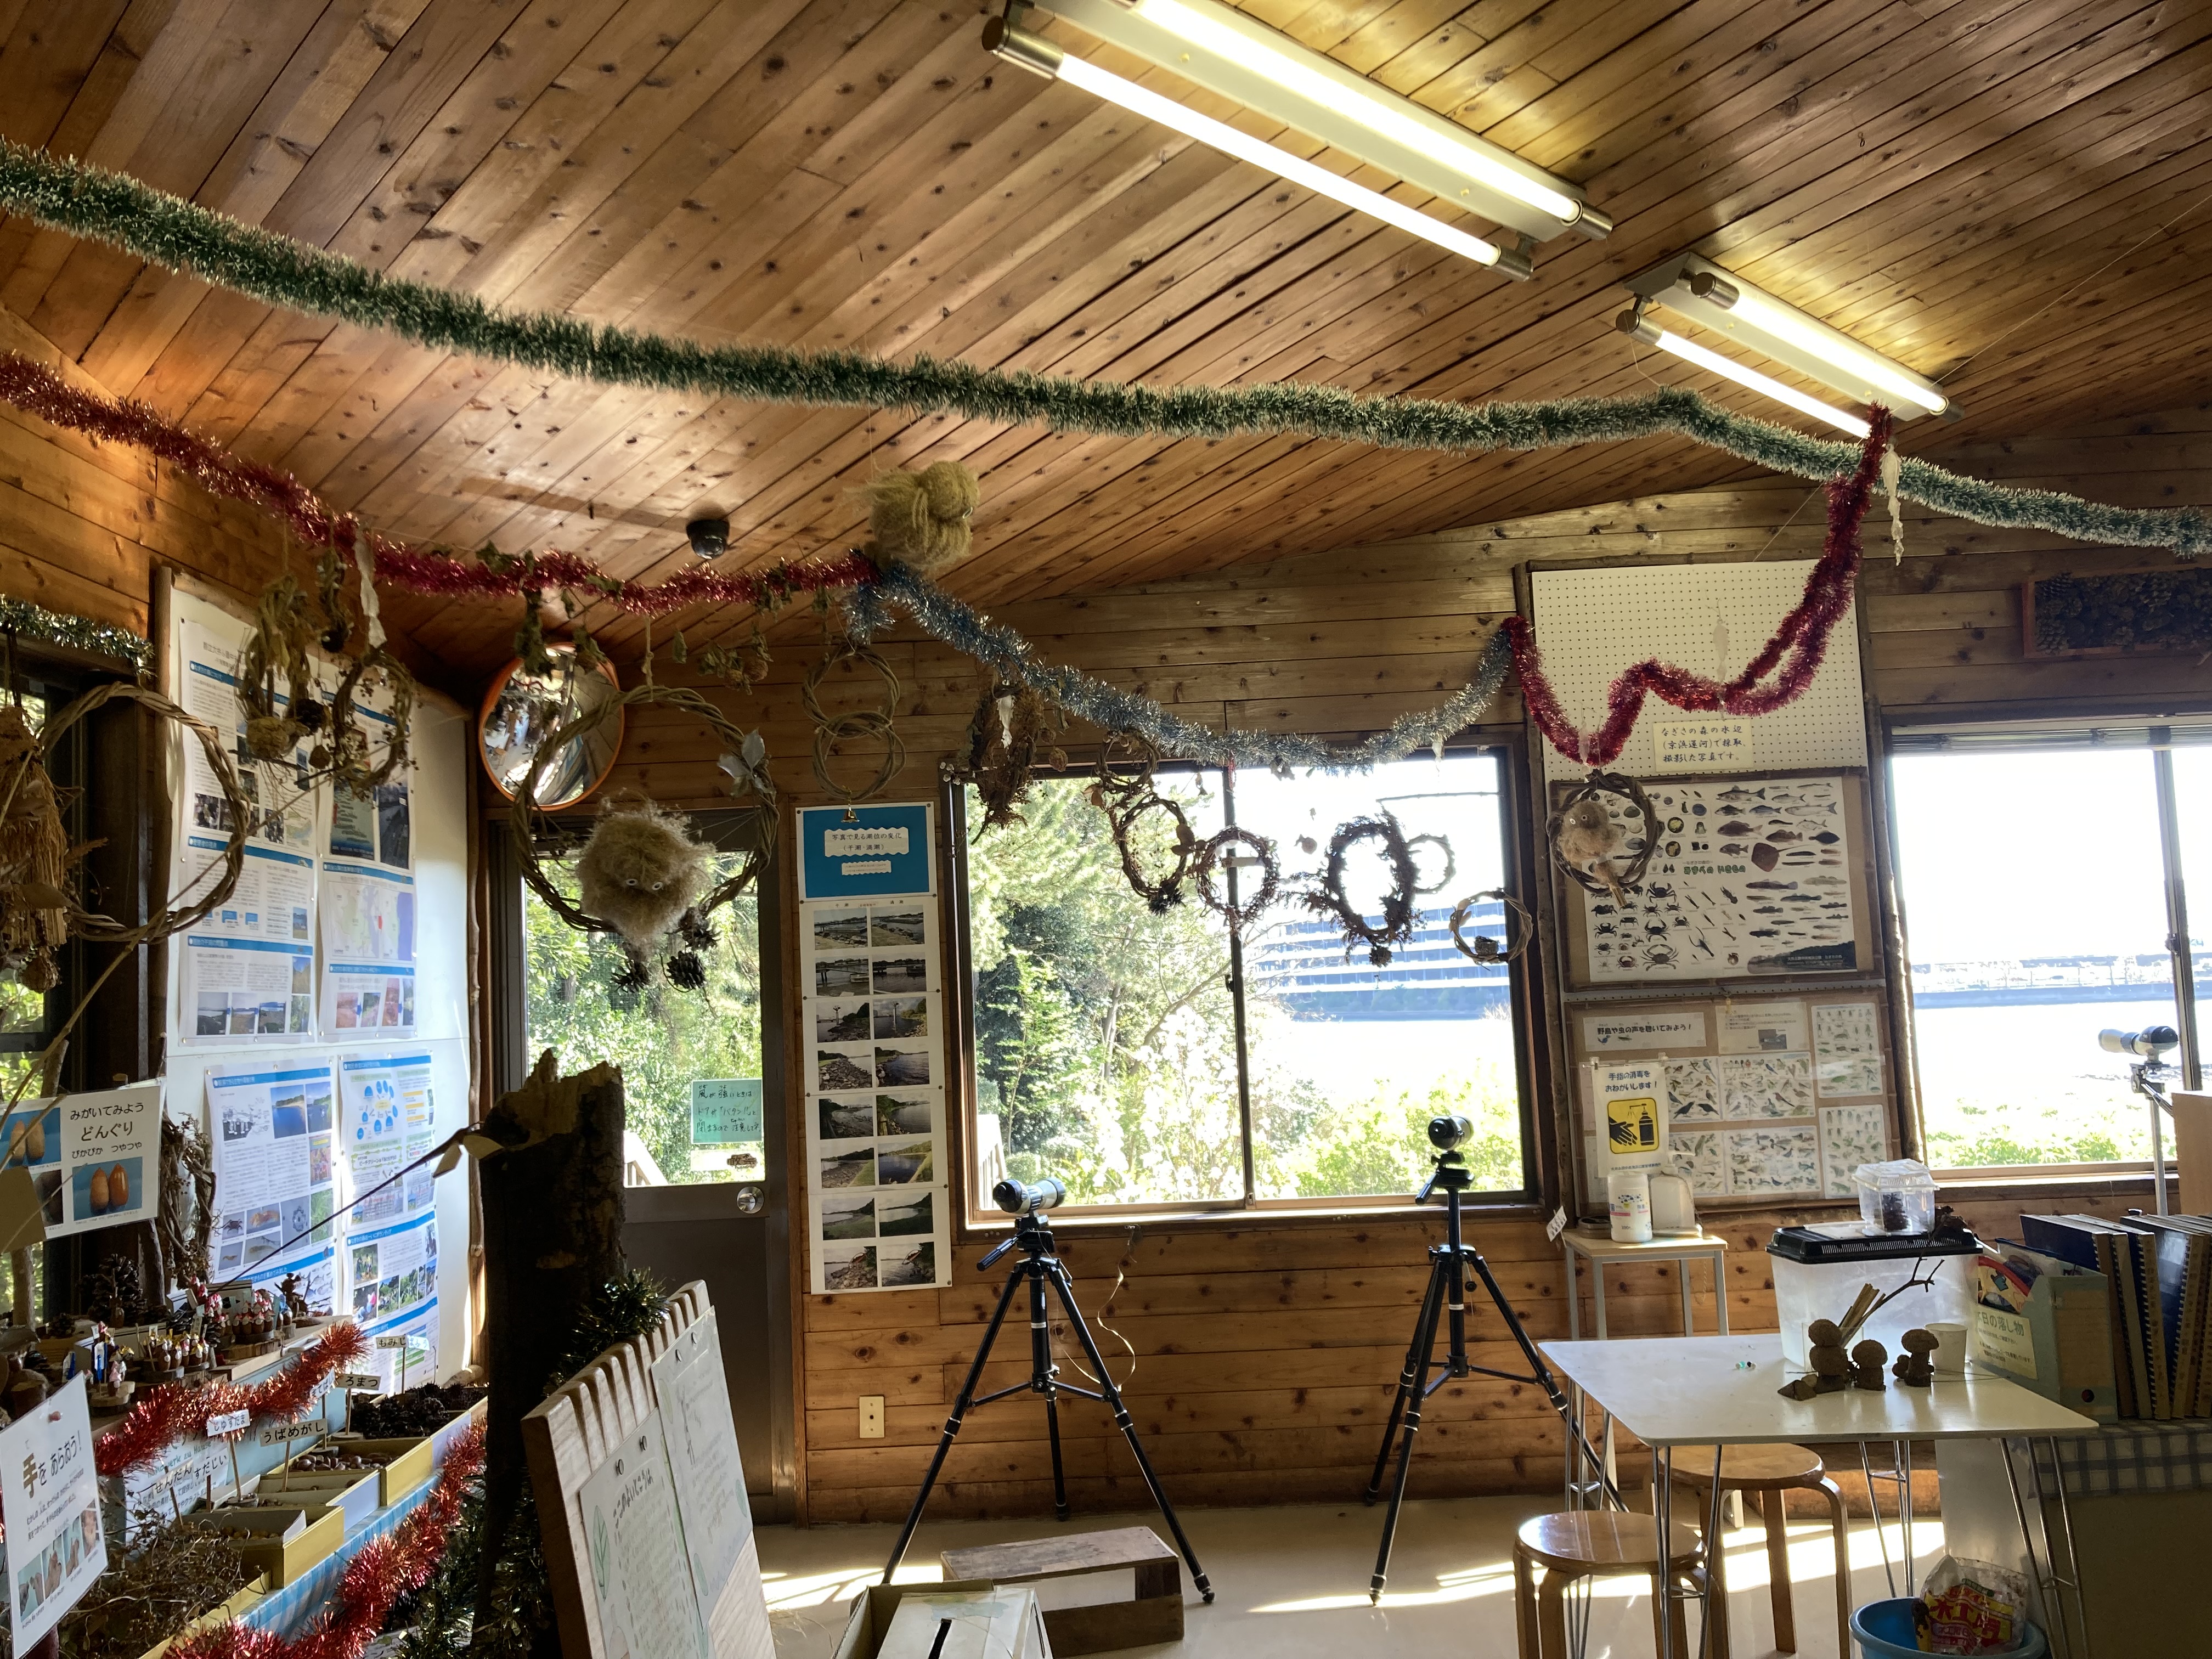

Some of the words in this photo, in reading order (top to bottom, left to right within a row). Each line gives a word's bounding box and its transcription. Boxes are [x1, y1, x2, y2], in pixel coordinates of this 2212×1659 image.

[1662, 725, 1742, 736] なぎさの森の水辺
[1663, 752, 1739, 763] 撮影した写真です。
[1609, 1070, 1650, 1080] 手指の消毒を
[70, 1102, 144, 1120] みがいてみよう
[81, 1121, 133, 1141] どんぐり
[111, 1142, 142, 1153] つやつや
[264, 1422, 324, 1443] うばめがし
[184, 1451, 192, 1459] zu
[194, 1442, 211, 1454] Hause
[194, 1455, 227, 1479] すだじい
[155, 1465, 191, 1493] せんだん
